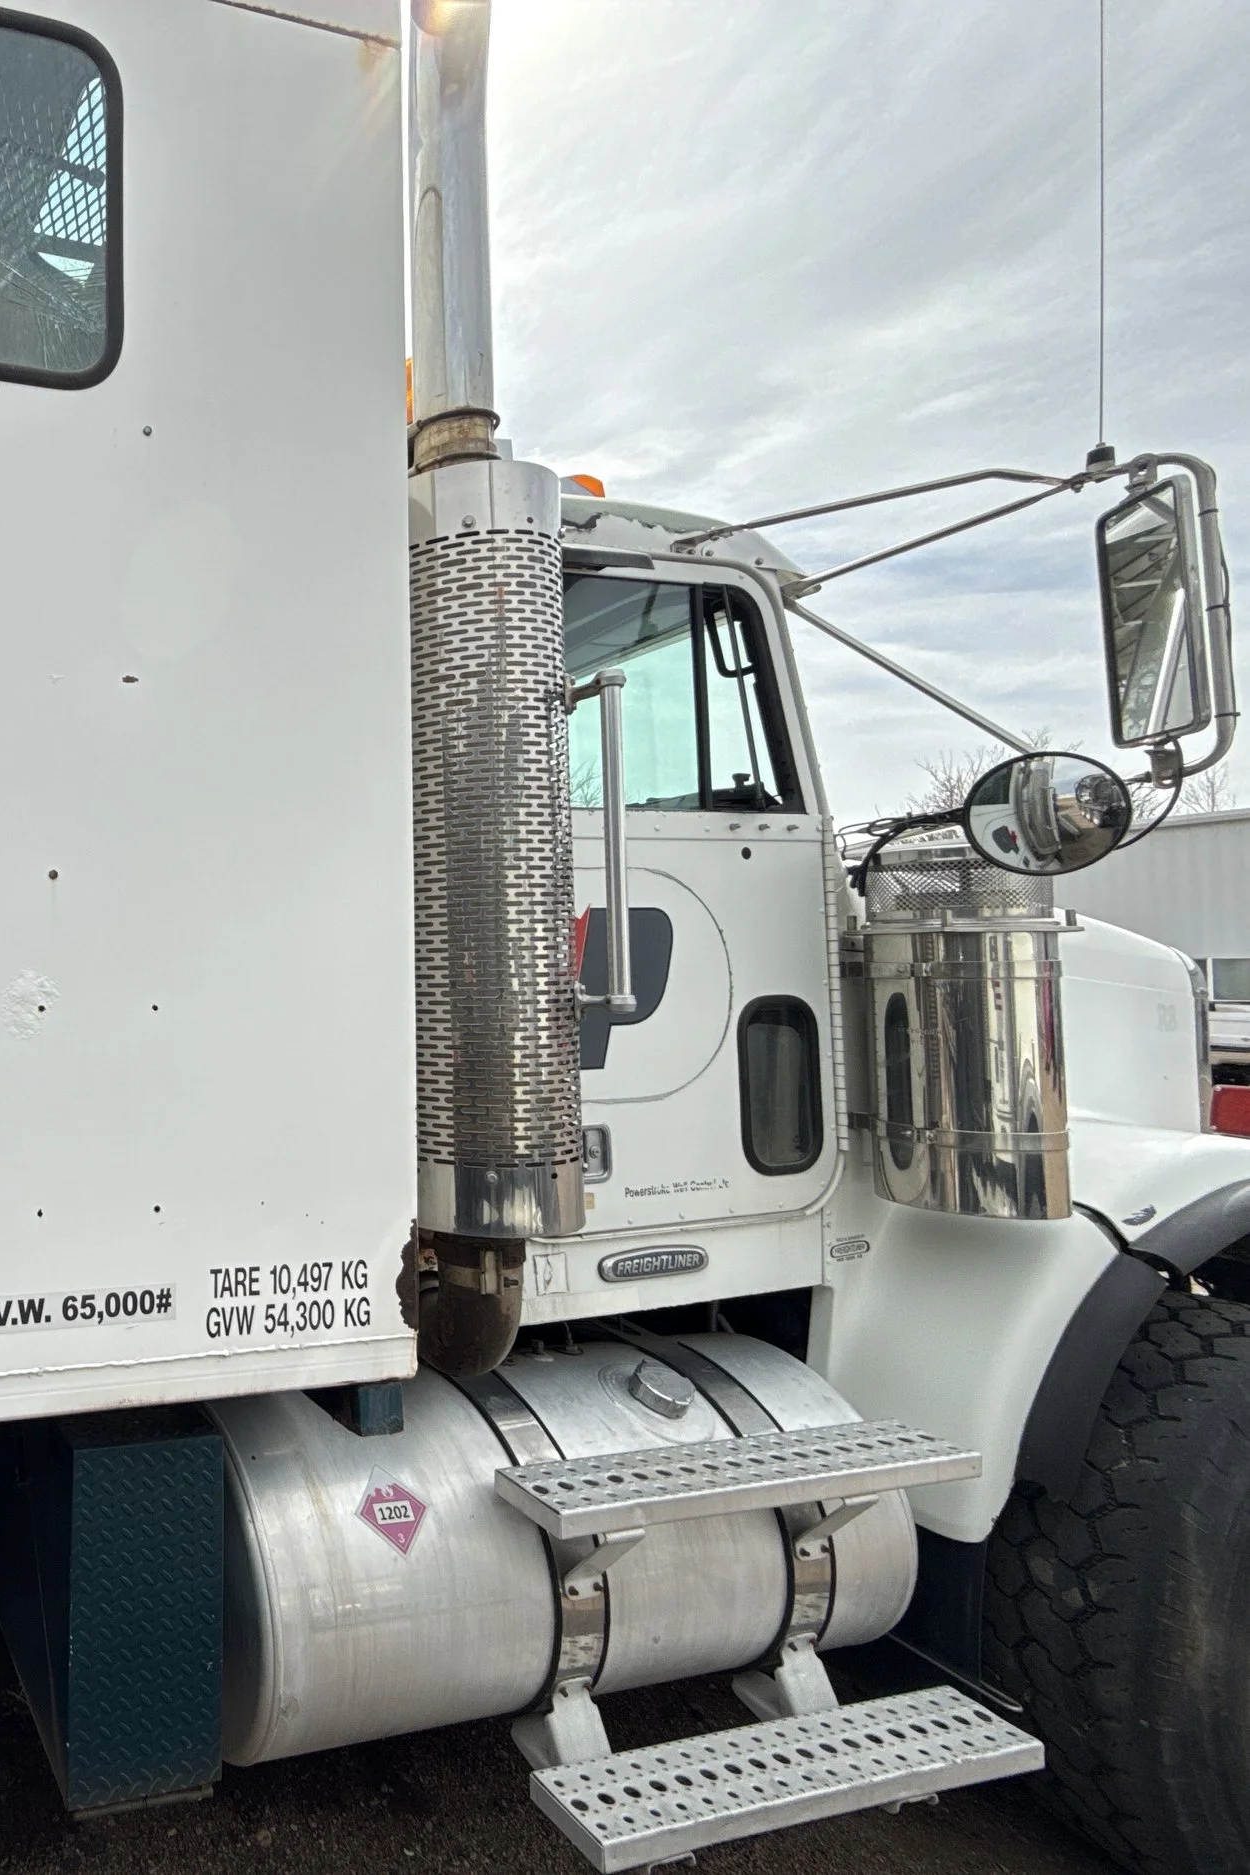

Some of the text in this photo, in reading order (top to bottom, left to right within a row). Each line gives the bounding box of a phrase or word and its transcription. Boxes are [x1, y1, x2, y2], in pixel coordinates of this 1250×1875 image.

[617, 1253, 700, 1275] FREIGHTLINER
[210, 1259, 369, 1301] TARE 10,497 KG
[61, 1288, 173, 1325] 65,000#
[206, 1296, 371, 1339] GVW 54,300 KG
[378, 1504, 411, 1521] 1202
[397, 1533, 406, 1543] 3
